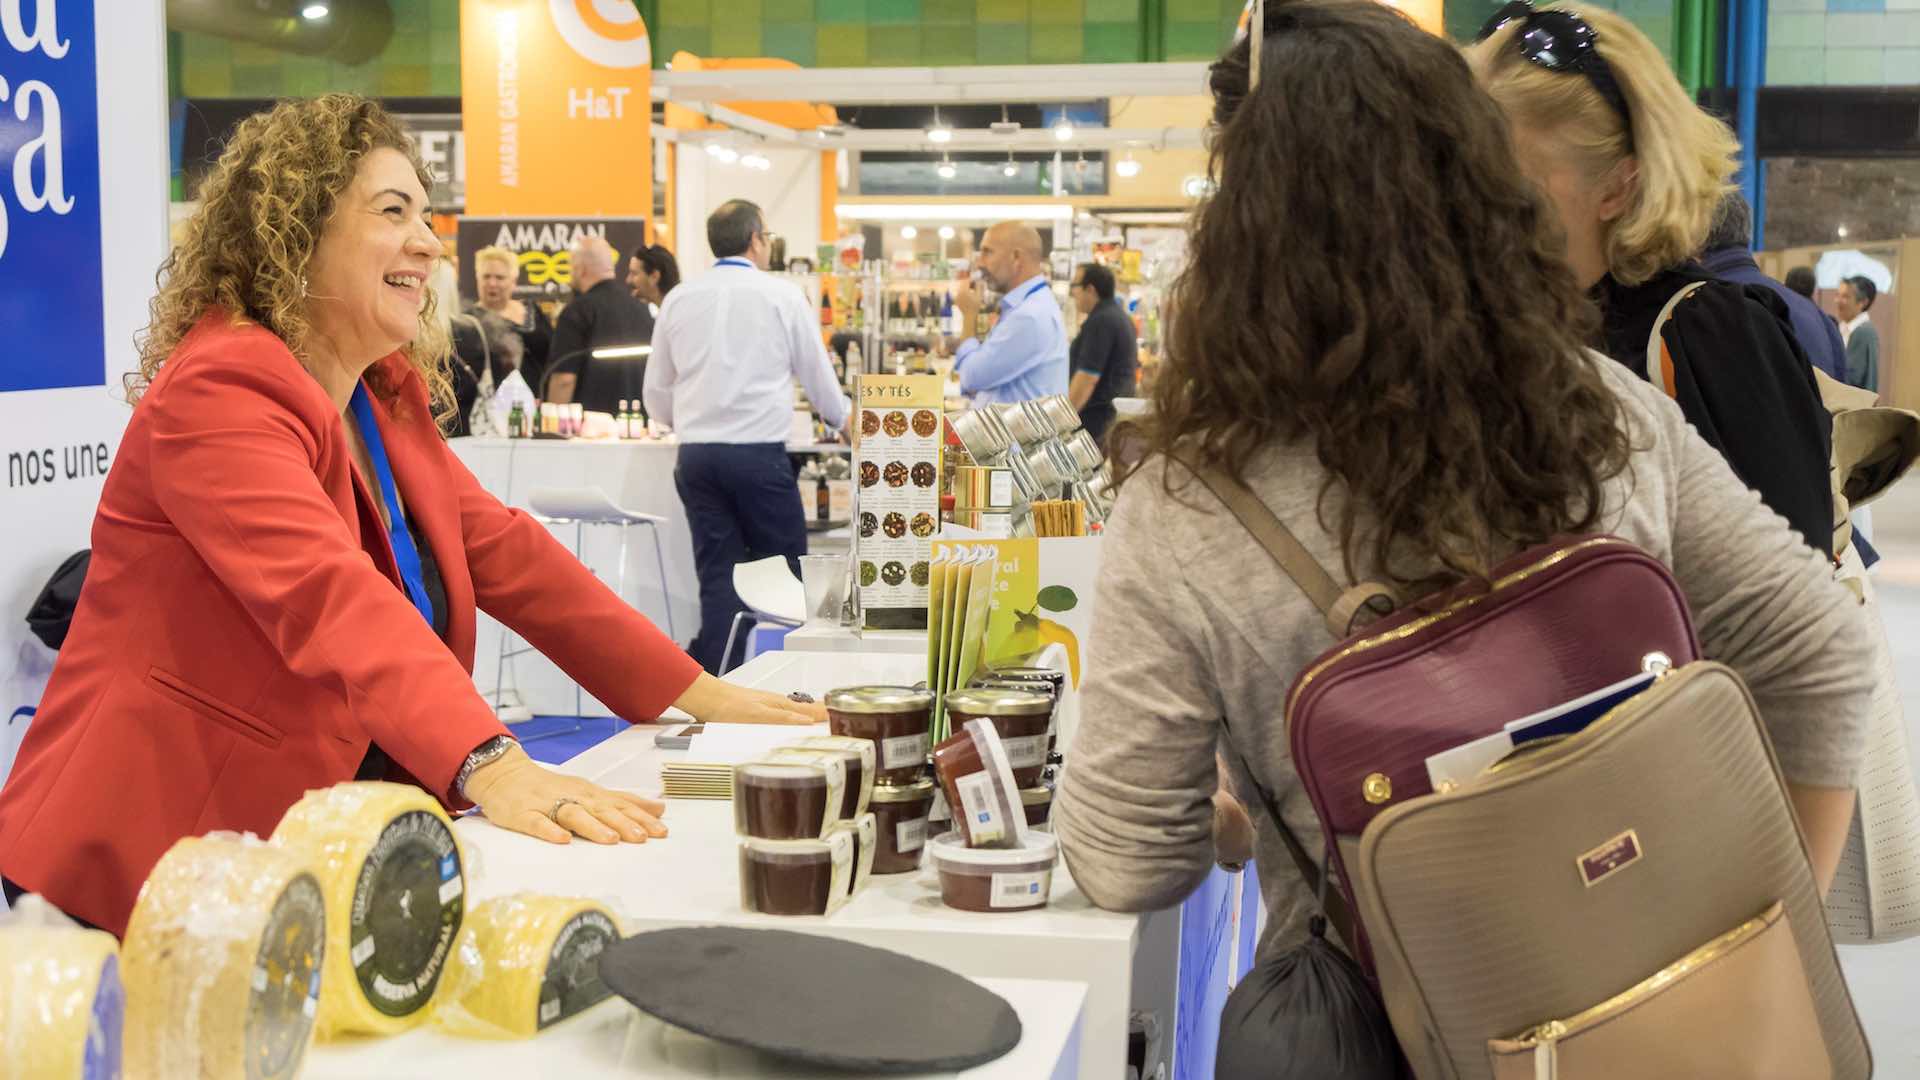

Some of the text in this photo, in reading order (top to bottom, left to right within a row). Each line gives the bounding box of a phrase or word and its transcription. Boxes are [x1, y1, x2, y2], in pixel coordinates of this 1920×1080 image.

[567, 87, 632, 120] H&T
[876, 385, 886, 397] Y
[889, 383, 912, 398] TÉS
[8, 442, 109, 488] nos une
